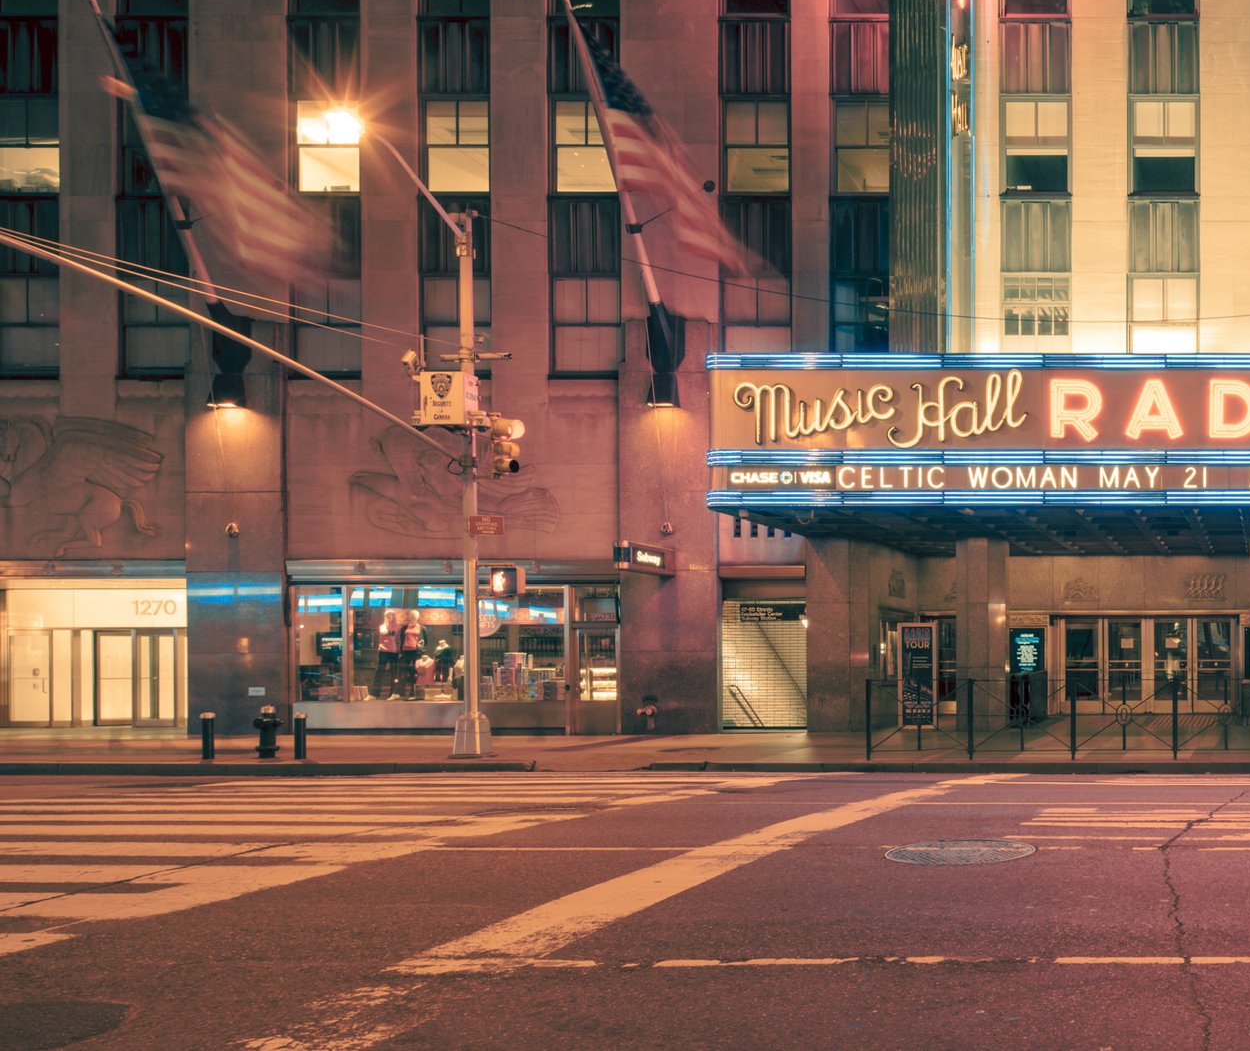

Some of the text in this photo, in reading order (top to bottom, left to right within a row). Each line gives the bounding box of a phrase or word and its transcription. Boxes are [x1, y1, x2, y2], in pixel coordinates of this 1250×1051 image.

[733, 368, 1028, 448] Music Hall
[730, 471, 779, 484] CHASE
[798, 471, 832, 484] VISA
[837, 466, 945, 489] CELTIC
[967, 466, 1078, 489] WOMAN
[1099, 466, 1160, 489] MAY
[1183, 466, 1207, 489] 21
[636, 550, 661, 566] Subway
[131, 599, 177, 616] 1270
[905, 641, 930, 649] TOUR
